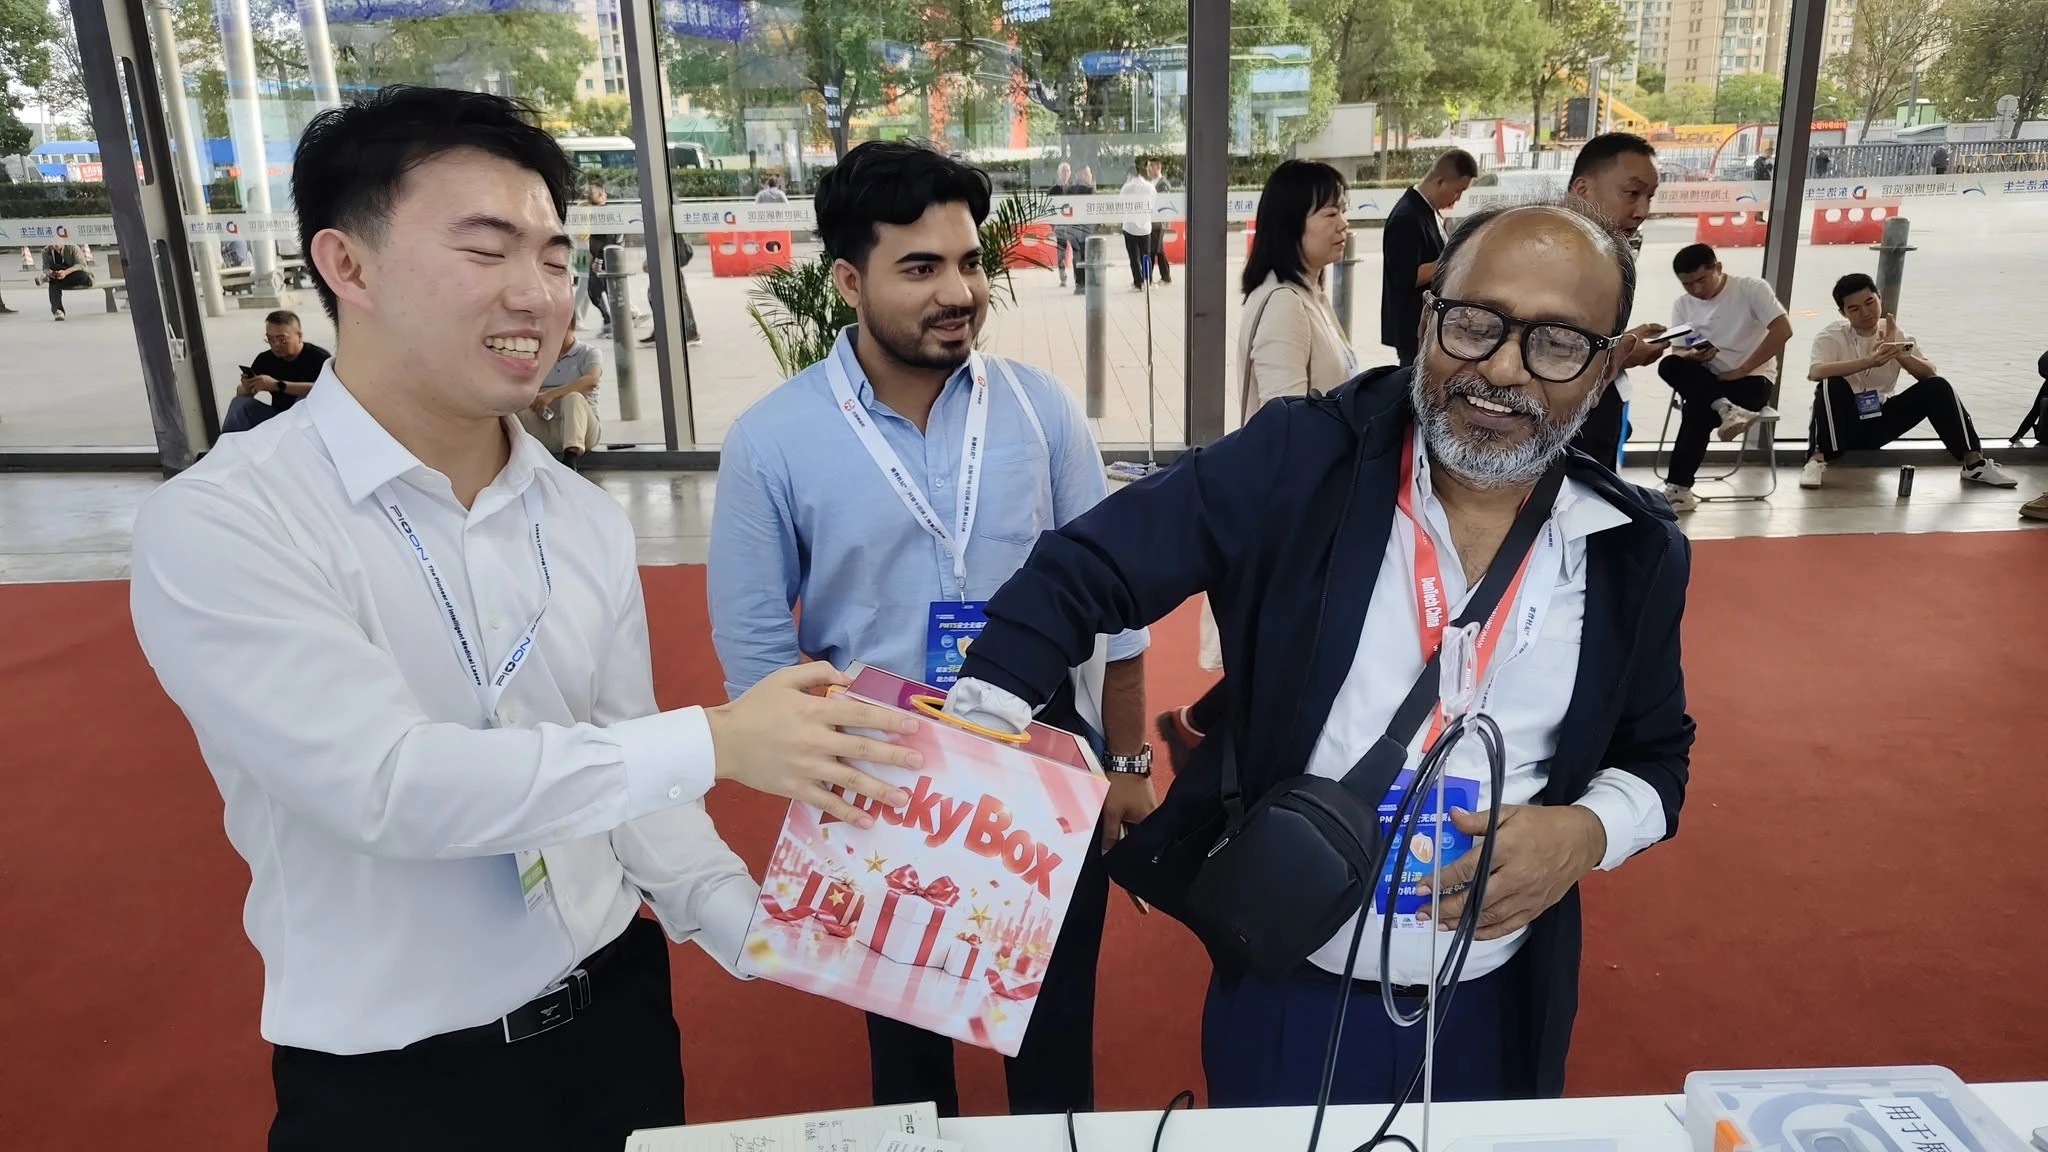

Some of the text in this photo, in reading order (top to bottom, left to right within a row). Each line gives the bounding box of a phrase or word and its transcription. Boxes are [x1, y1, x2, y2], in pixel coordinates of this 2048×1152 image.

[433, 576, 448, 601] Pioneer
[447, 608, 465, 640] Intelligent
[461, 638, 475, 665] Medical
[1425, 606, 1444, 628] China
[964, 793, 1063, 900] Box
